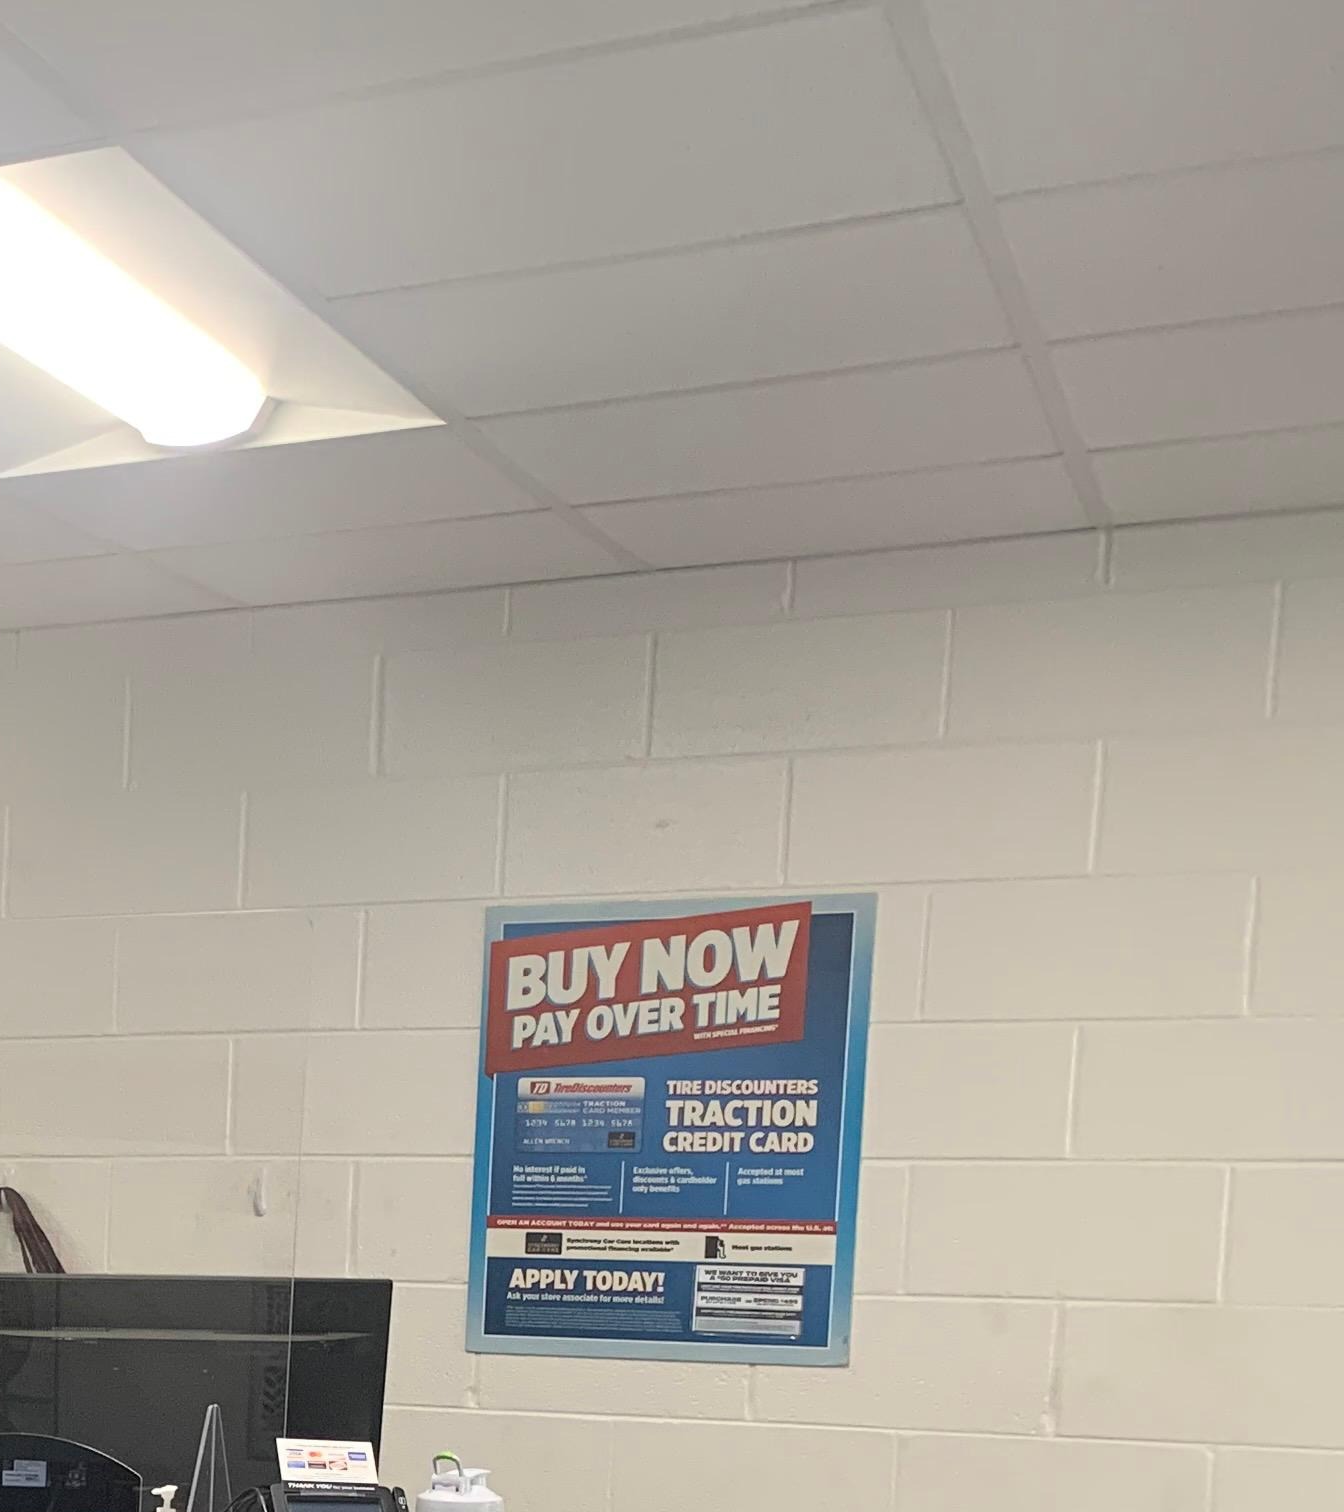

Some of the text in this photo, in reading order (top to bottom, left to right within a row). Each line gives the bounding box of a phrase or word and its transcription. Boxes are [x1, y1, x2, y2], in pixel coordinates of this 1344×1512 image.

[507, 920, 800, 1010] BUY NOW
[512, 984, 781, 1049] PAY OVER TIME
[693, 1032, 711, 1040] WITH
[712, 1028, 737, 1038] SPECIAL
[554, 1083, 632, 1094] TireDiscounters
[666, 1080, 819, 1096] TIRE DISCOUNTERS
[665, 1100, 817, 1127] TRACTION
[663, 1131, 815, 1153] CREDIT CARD
[513, 1165, 523, 1173] No
[525, 1165, 553, 1173] interest
[560, 1165, 577, 1175] paid
[633, 1166, 694, 1175] Exclusive offers,
[737, 1167, 804, 1177] Accepted at most
[513, 1174, 525, 1182] full
[526, 1174, 549, 1182] within
[632, 1176, 669, 1184] discounts
[677, 1176, 717, 1185] cardholder
[737, 1177, 783, 1186] gas stations
[632, 1185, 680, 1194] only benefits
[497, 1218, 518, 1226] OPEN
[530, 1219, 567, 1227] ACCOUNT
[568, 1220, 594, 1228] TODAY
[729, 1223, 766, 1231] Accepted
[566, 1237, 602, 1246] Synchrony
[632, 1238, 664, 1246] locations
[509, 1268, 665, 1292] APPLY TODAY!
[507, 1291, 521, 1300] Ask
[522, 1293, 540, 1302] your
[541, 1292, 561, 1301] store
[562, 1294, 598, 1302] associate
[599, 1294, 612, 1302] for
[635, 1295, 665, 1304] details!
[288, 1482, 315, 1490] THANK
